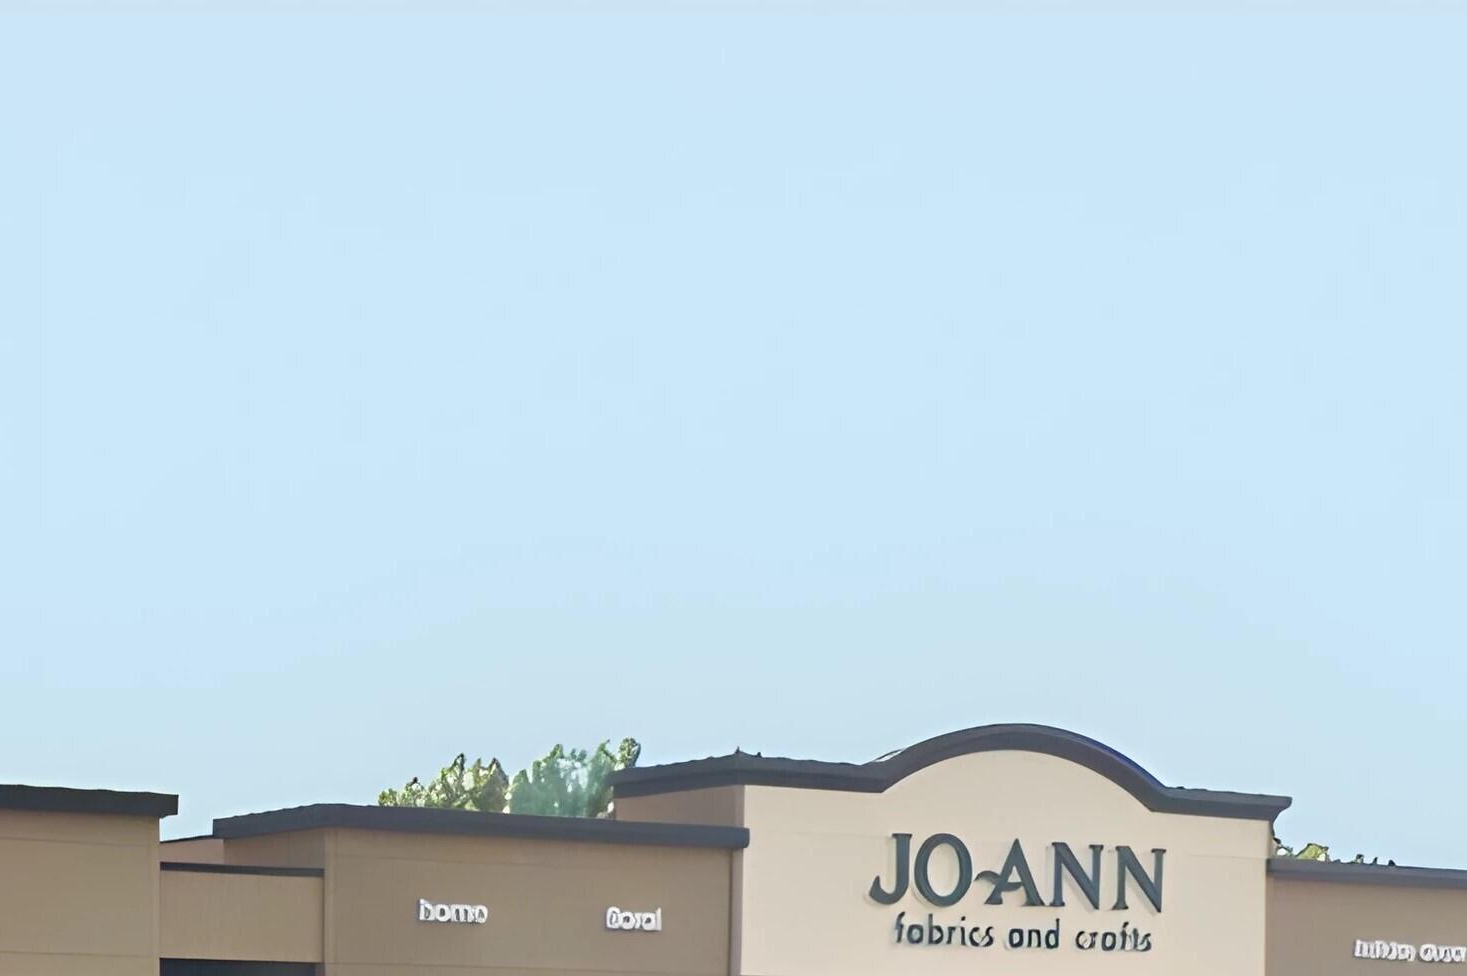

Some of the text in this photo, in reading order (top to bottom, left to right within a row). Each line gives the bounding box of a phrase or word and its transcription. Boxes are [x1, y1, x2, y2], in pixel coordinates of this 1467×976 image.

[868, 832, 1167, 914] JOANN
[895, 911, 1153, 952] fabrics and crafts
